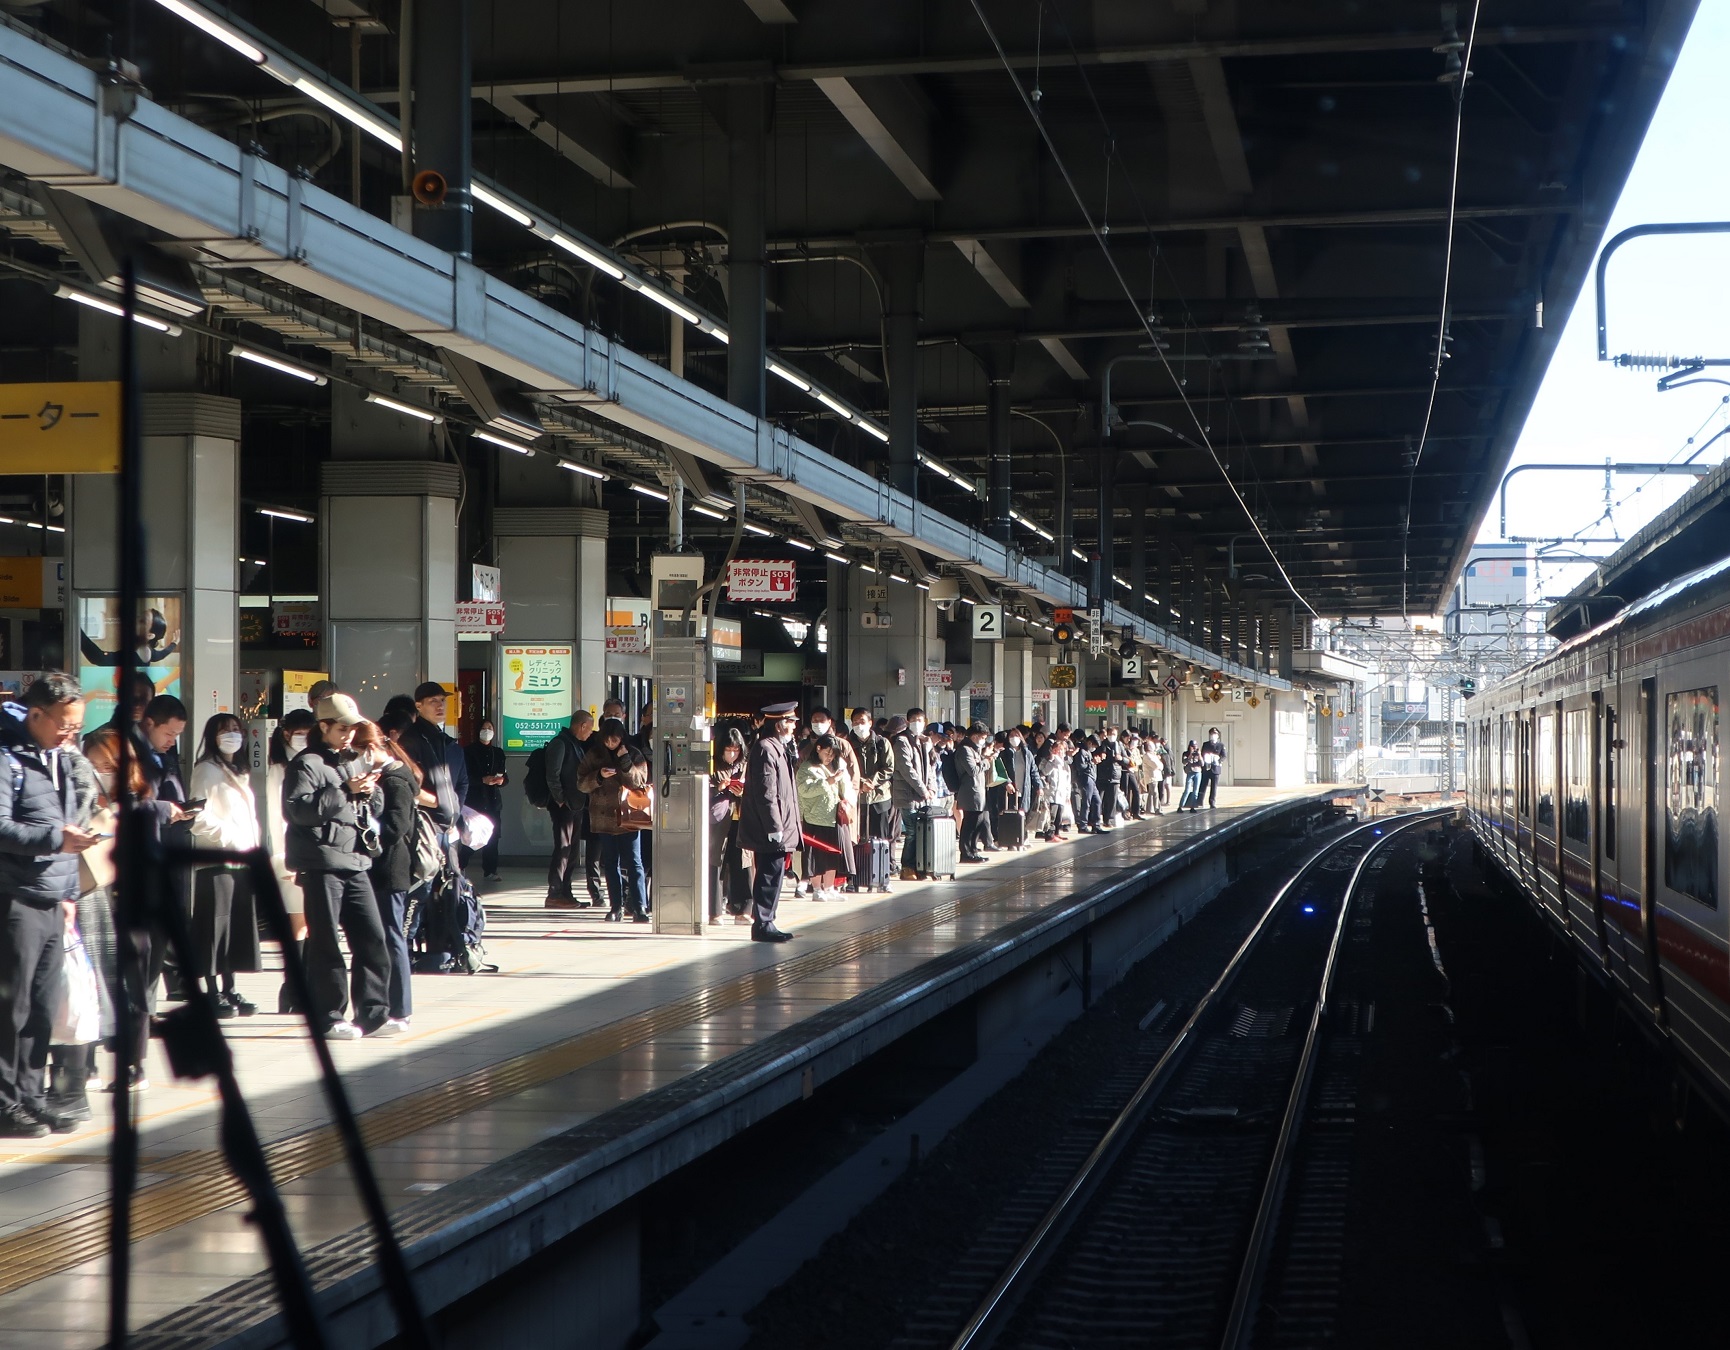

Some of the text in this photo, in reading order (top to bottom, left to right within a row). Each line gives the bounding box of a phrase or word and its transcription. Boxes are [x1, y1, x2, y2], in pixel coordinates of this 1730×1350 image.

[733, 567, 769, 577] 非常停止
[738, 578, 764, 587] ボタン
[867, 589, 887, 599] 接近
[456, 607, 485, 615] 非常停止
[979, 611, 995, 632] 2
[528, 659, 562, 667] レディース
[1127, 660, 1137, 674] 2
[528, 675, 562, 687] ミュウ
[1166, 678, 1176, 690] 4
[1212, 691, 1220, 701] 6
[1235, 690, 1242, 700] 2
[1251, 698, 1257, 707] 8
[253, 741, 261, 768] AED
